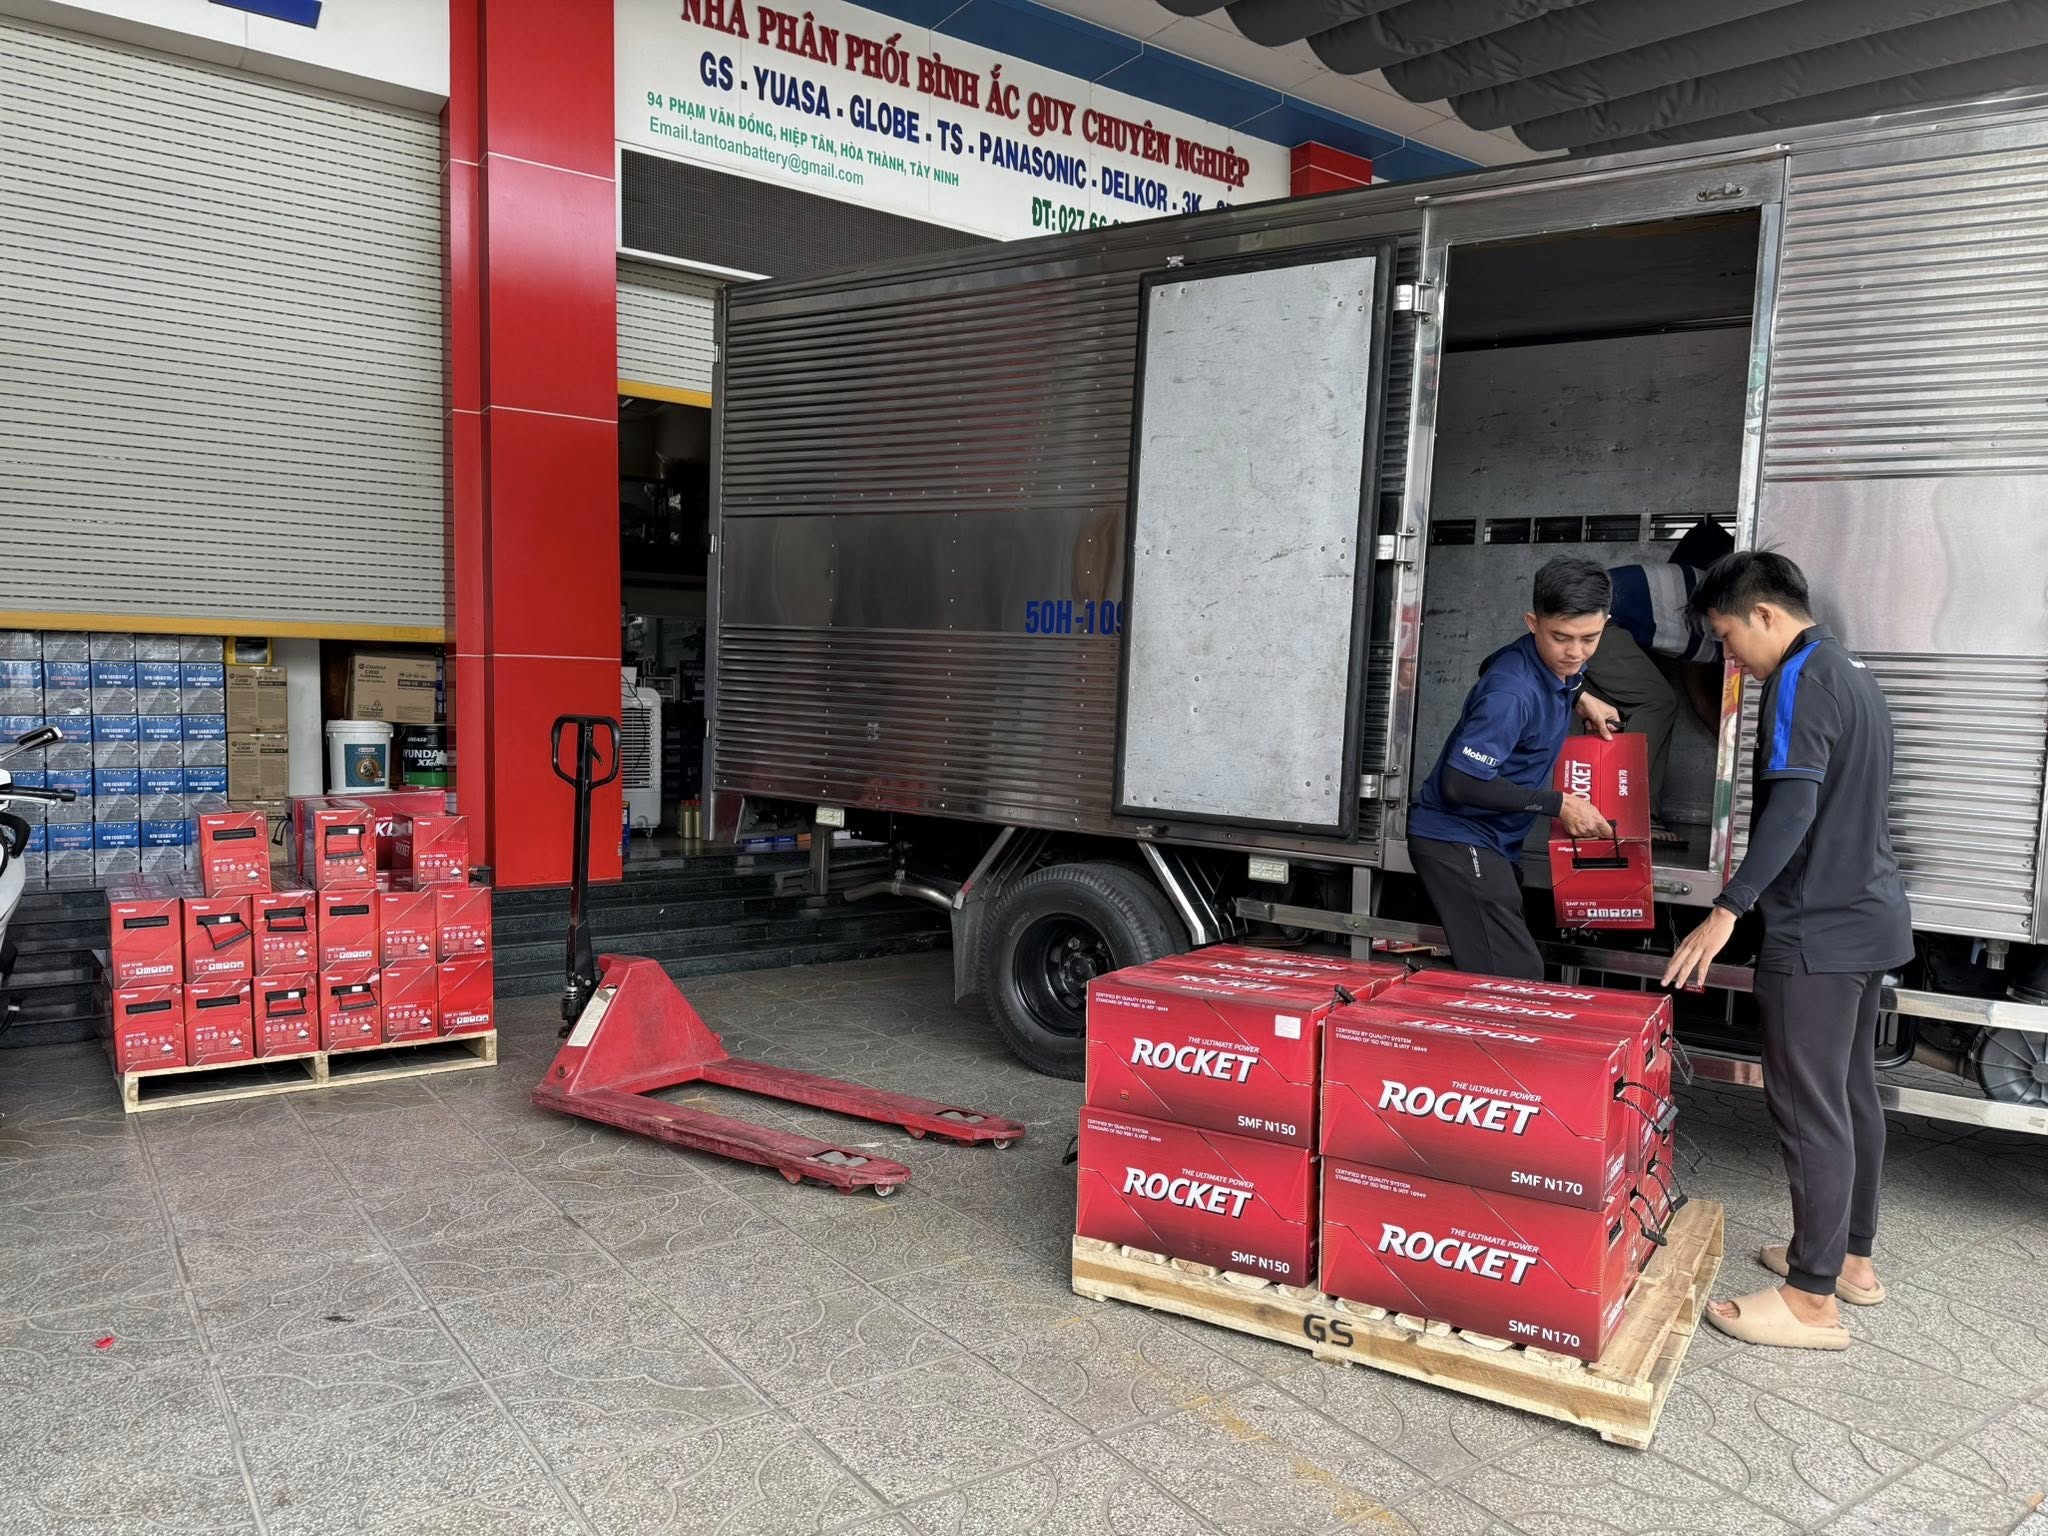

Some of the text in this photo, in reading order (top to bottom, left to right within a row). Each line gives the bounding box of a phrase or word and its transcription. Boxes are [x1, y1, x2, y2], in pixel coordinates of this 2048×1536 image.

[757, 5, 839, 66] PHÂN
[845, 33, 910, 88] PHỐI
[917, 52, 980, 109] BÌNH
[985, 64, 1020, 120] ẮC
[1028, 92, 1076, 136] QUY
[1082, 108, 1171, 166] CHUYÊN
[1175, 137, 1249, 192] NGHIỆP
[647, 91, 959, 187] 94 PHẠM VĂN ĐỒNG, HIỆP TÂN, HÒA THÀNH, TÂY NINH
[700, 51, 733, 91] GS
[753, 65, 831, 119] YUASA
[850, 94, 920, 144] GLOBE
[937, 119, 963, 155] TS
[979, 131, 1087, 189] PANASONIC
[1101, 165, 1168, 212] DELKOR
[1462, 746, 1488, 763] Mobil
[1188, 1036, 1260, 1054] THE ULTIMATE POWER
[1335, 1026, 1360, 1035] CERTIFIED
[1368, 1032, 1391, 1040] QUALITY
[1391, 1035, 1412, 1044] SYSTEM
[1335, 1033, 1361, 1042] STANDARD
[1131, 1037, 1259, 1083] ROCKET
[1451, 1080, 1542, 1103] THE ULTIMATE POWER
[1378, 1079, 1540, 1136] ROCKET
[1237, 1115, 1296, 1136] SMF N150
[1181, 1168, 1255, 1189] THE ULTIMATE POWER
[1335, 1168, 1360, 1177] CERTIFIED
[1368, 1175, 1390, 1184] QUALITY
[1390, 1180, 1411, 1189] SYSTEM
[1335, 1174, 1361, 1185] STANDARD
[1511, 1170, 1583, 1196] SMF N170
[1123, 1166, 1253, 1218] ROCKET
[1450, 1227, 1539, 1253] THE ULTIMATE POWER
[1231, 1250, 1290, 1274] SMF N150
[1378, 1222, 1537, 1285] ROCKET
[1302, 1314, 1355, 1347] GS
[1508, 1320, 1581, 1347] SMF N170
